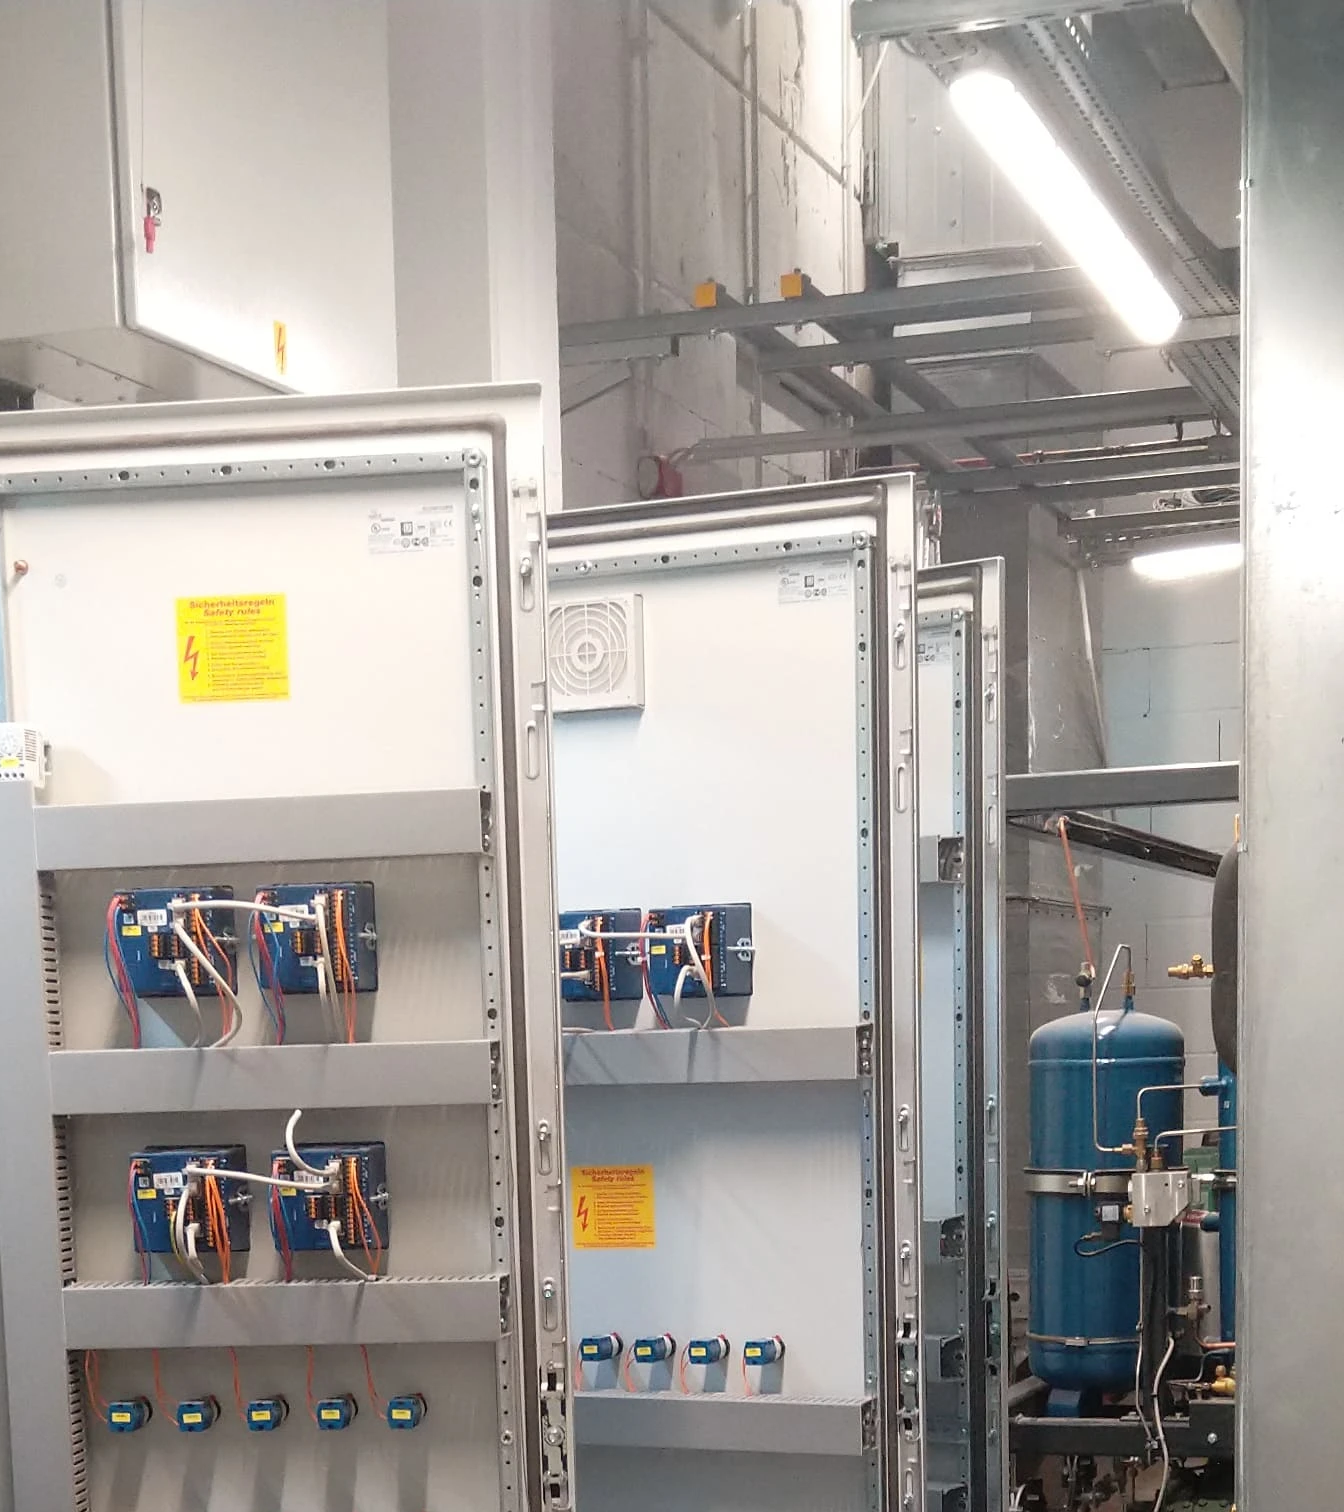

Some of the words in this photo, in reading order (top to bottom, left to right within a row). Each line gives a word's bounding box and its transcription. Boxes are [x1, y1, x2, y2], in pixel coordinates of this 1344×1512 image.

[189, 598, 275, 609] Sicherheitsregeln
[203, 607, 234, 617] Safety
[236, 607, 261, 615] rules
